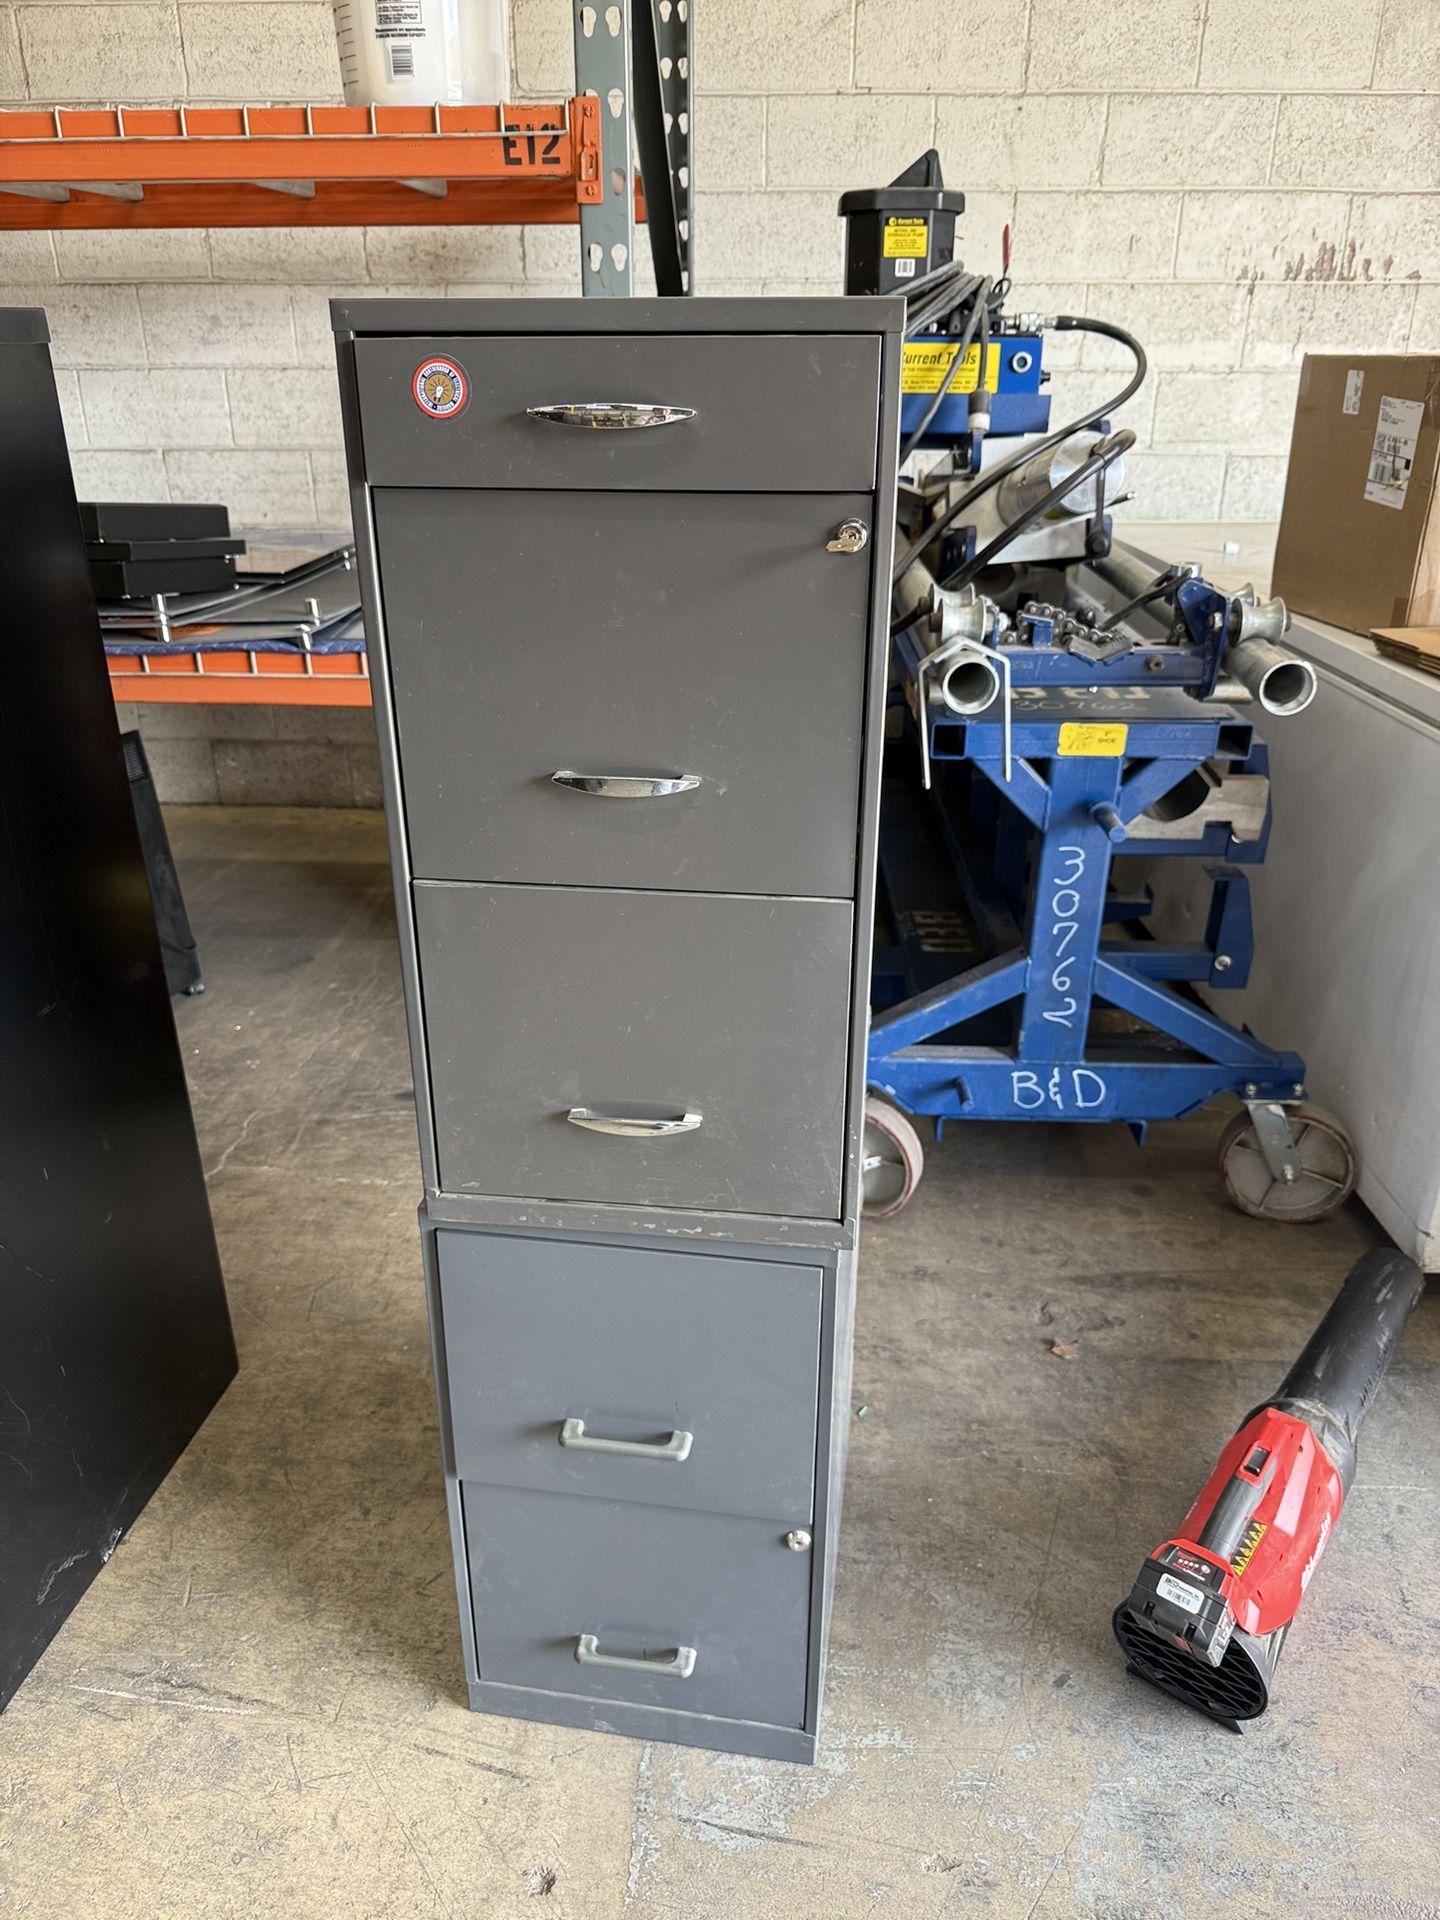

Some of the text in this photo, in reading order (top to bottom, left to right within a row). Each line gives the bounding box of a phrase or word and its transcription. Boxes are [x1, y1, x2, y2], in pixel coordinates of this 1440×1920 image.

[502, 123, 561, 166] E12
[903, 351, 942, 365] urrent
[1042, 846, 1086, 1028] 30762
[1010, 1066, 1107, 1110] B&D
